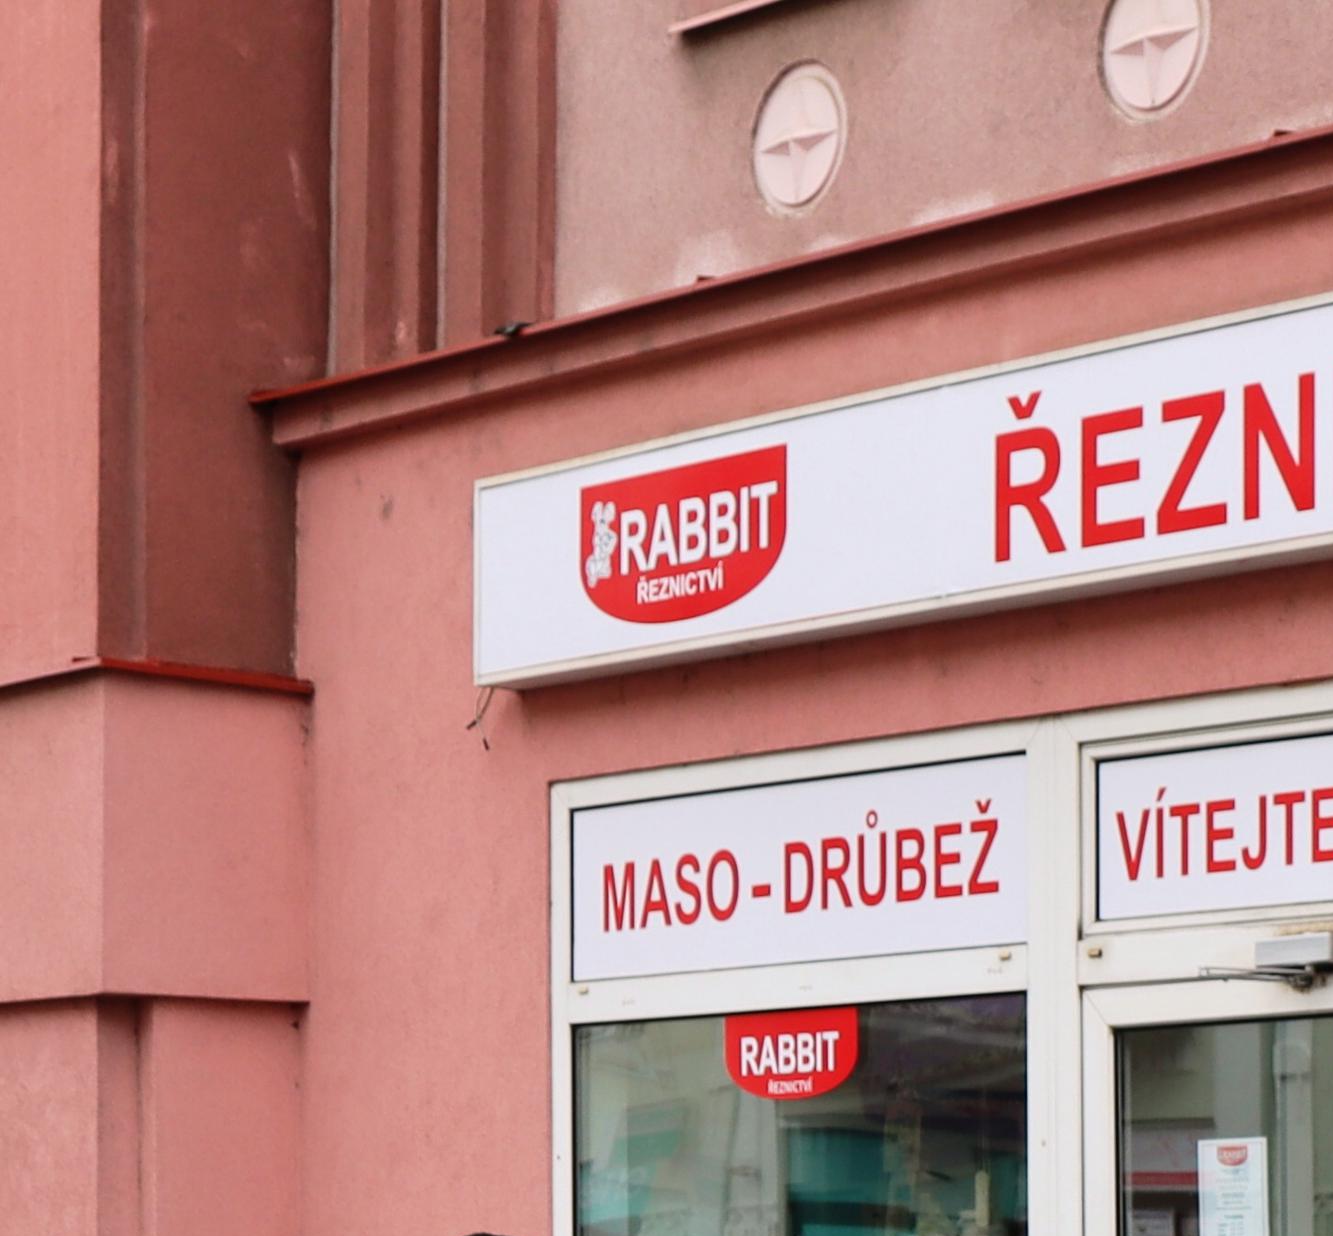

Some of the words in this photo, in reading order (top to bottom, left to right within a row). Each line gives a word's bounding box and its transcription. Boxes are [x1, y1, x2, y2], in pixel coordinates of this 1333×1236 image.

[621, 481, 778, 576] RABBIT
[636, 561, 724, 604] ŘEZNICTVÍ
[740, 1030, 840, 1077] RABBIT
